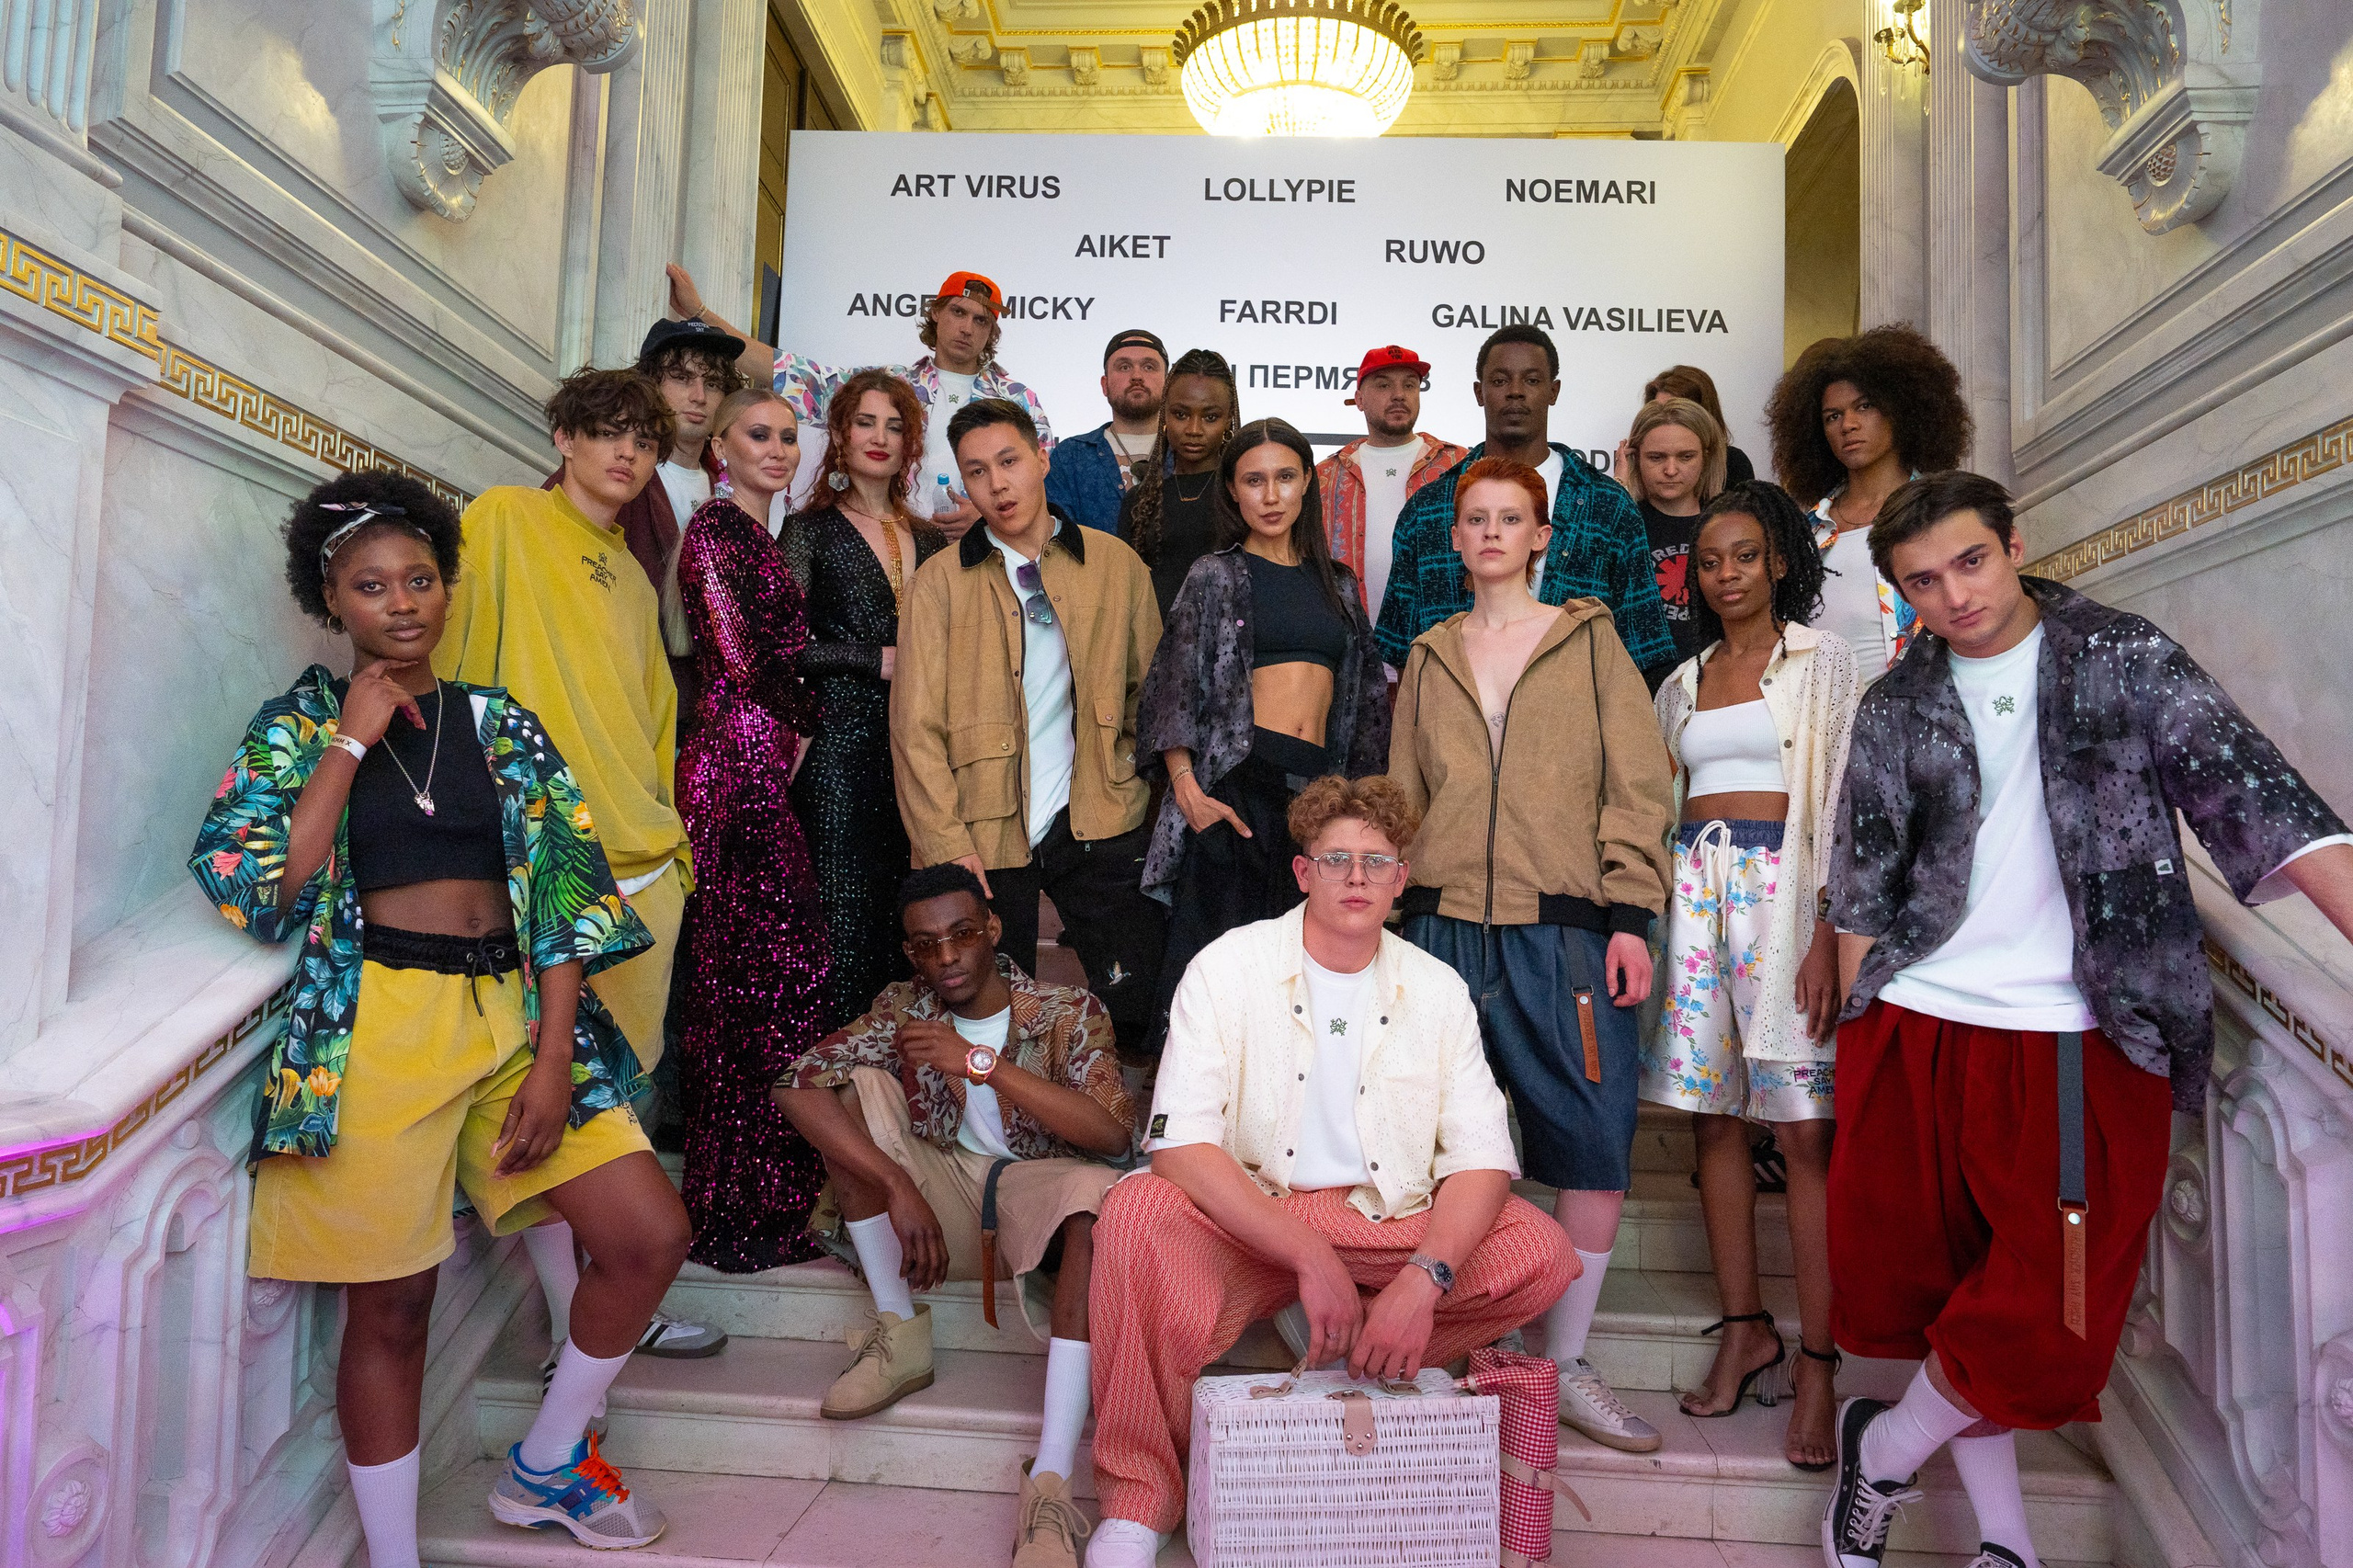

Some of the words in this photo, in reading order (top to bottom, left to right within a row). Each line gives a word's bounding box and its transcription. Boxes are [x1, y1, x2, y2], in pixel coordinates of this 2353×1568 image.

[890, 174, 956, 198] ART
[965, 175, 1061, 199] VIRUS
[1204, 177, 1356, 203] LOLLYPIE
[1506, 178, 1656, 205] NOEMARI
[1074, 234, 1171, 259] AIKET
[1385, 239, 1485, 265] RUWO
[847, 293, 938, 317] ANGE
[1220, 300, 1337, 325] FARRDI
[1432, 303, 1554, 330] GALINA
[1563, 307, 1729, 334] VASILIEVA
[1250, 364, 1431, 392] ПЕРМЯ
[581, 555, 617, 587] PREACHER
[589, 574, 611, 594] AMEN
[1793, 1068, 1836, 1082] PREACH
